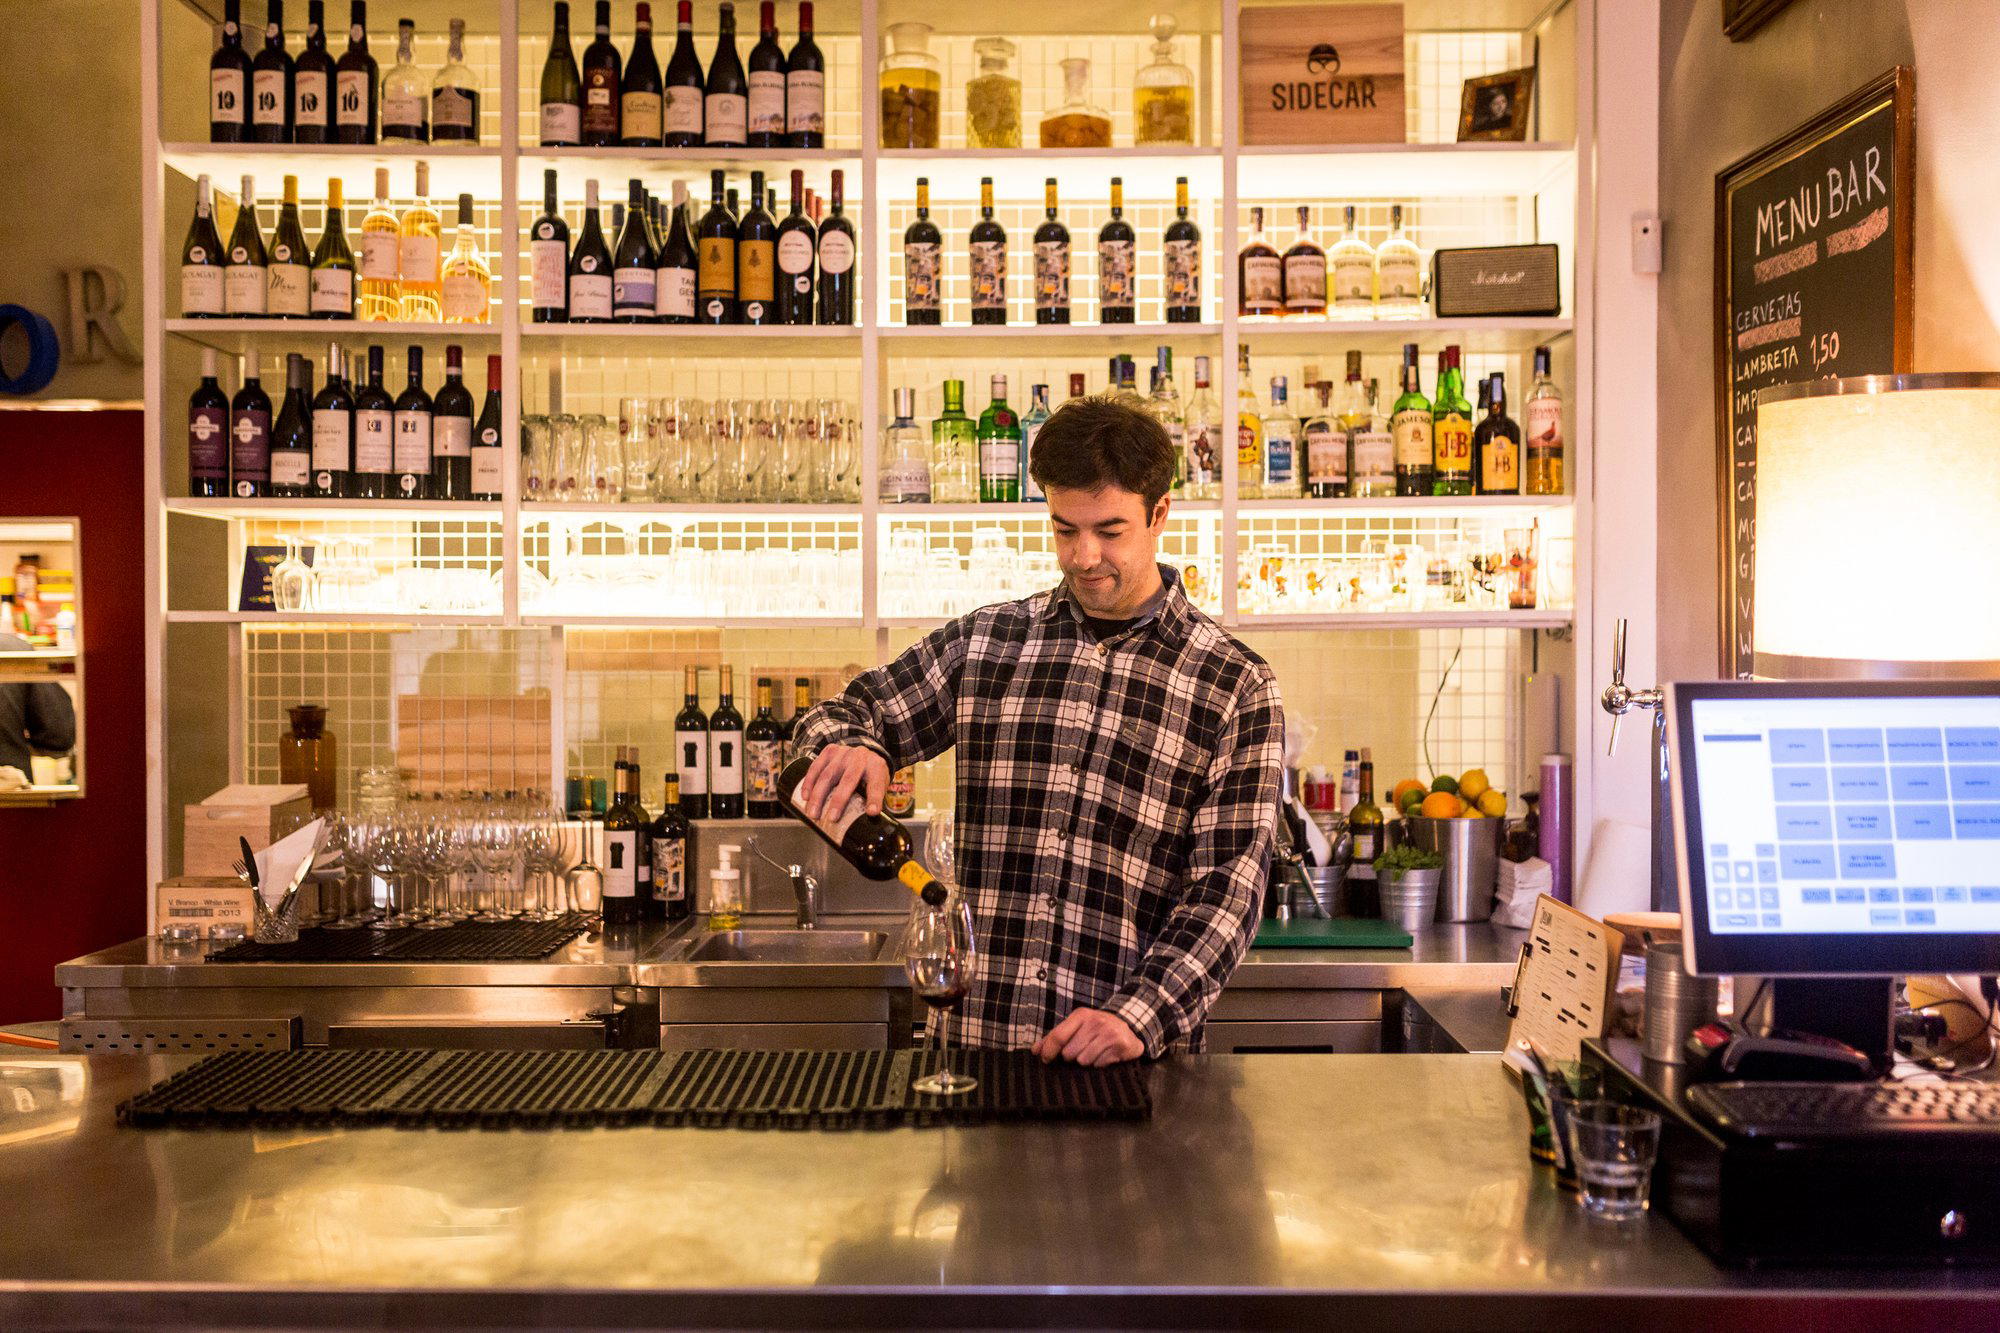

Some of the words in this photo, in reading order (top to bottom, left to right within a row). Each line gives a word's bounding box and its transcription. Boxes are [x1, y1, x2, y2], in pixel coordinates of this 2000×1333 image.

[217, 90, 235, 110] 10
[258, 91, 276, 111] 10
[300, 92, 318, 112] 10
[342, 92, 359, 112] 10
[1272, 80, 1376, 111] SIDECAR
[1756, 182, 1821, 256] MENU
[1826, 146, 1886, 219] BAR
[1736, 291, 1802, 331] CERVEJAS
[1736, 345, 1799, 382] LAMBRETA
[218, 909, 241, 917] 2013
